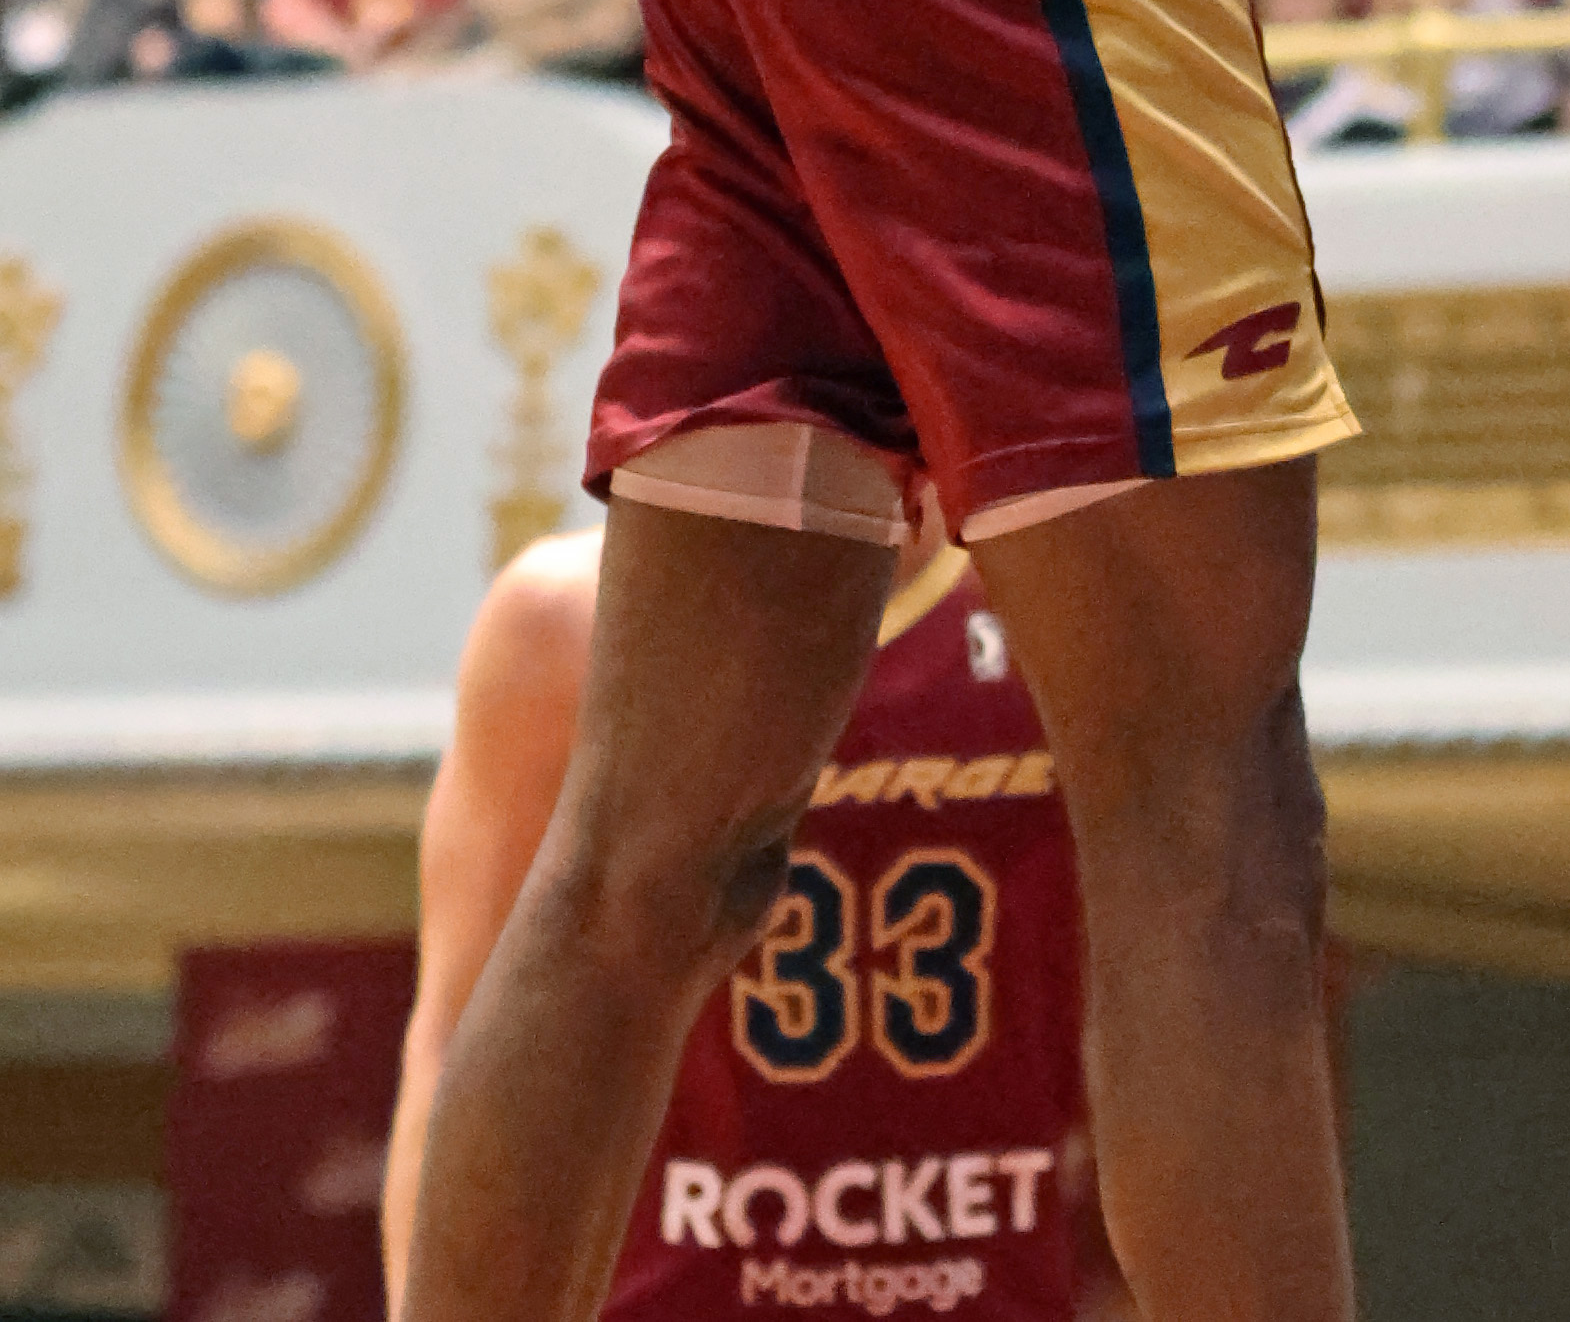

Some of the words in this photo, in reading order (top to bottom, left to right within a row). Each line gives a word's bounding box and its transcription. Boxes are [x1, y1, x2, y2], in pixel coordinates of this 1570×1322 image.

[810, 752, 1054, 810] ARGE
[731, 845, 996, 1085] 33
[660, 1148, 1055, 1249] ROCKET
[739, 1256, 987, 1317] Mortgage
